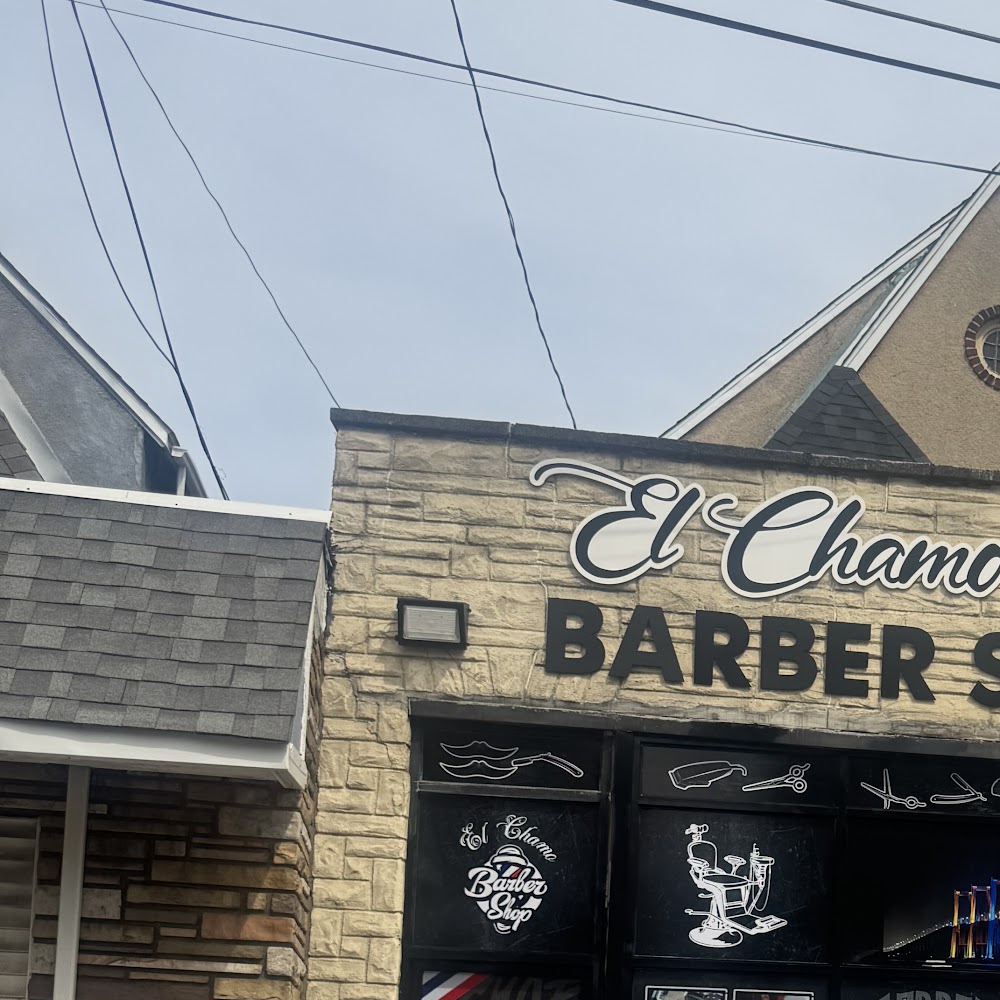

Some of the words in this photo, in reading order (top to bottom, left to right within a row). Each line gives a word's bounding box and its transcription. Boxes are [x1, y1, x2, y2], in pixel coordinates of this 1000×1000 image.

[532, 460, 701, 583] El
[545, 598, 936, 703] BARBER
[459, 822, 489, 850] El
[496, 814, 557, 863] Chamo
[464, 867, 547, 898] Barber
[487, 892, 532, 932] Shop
